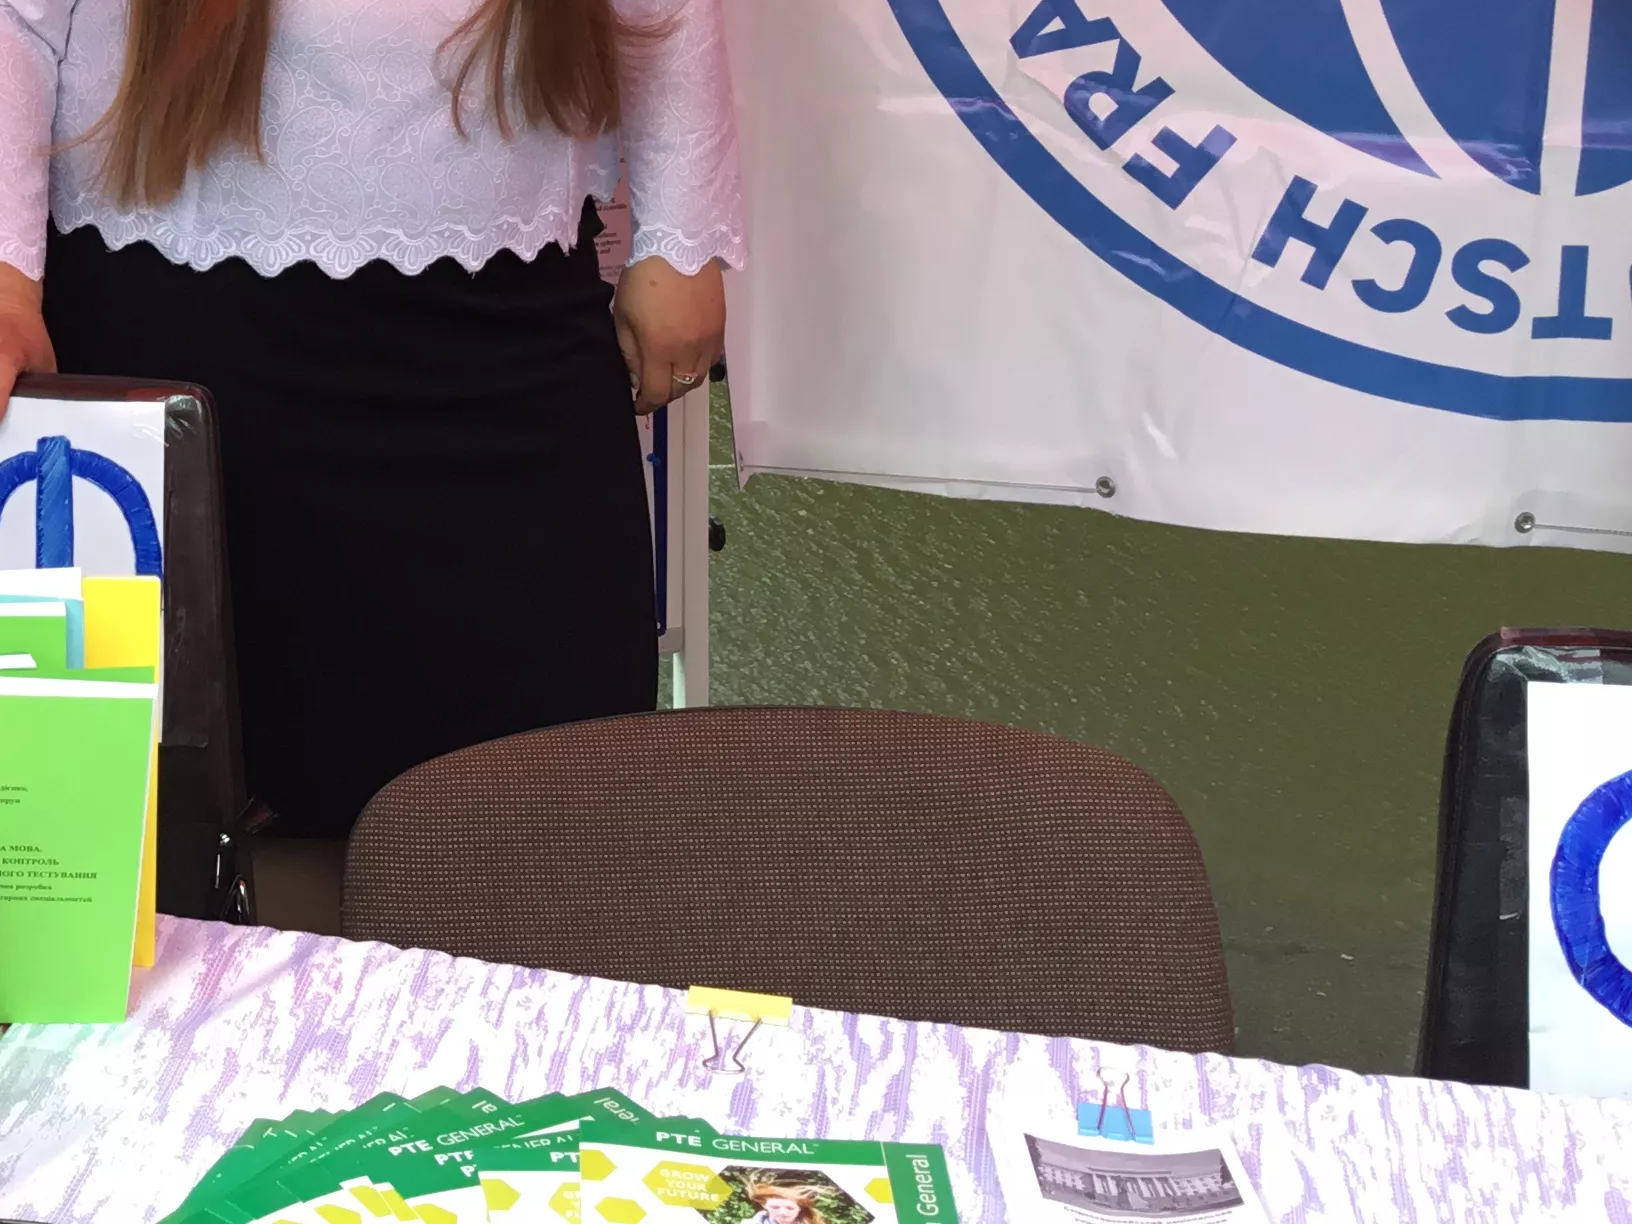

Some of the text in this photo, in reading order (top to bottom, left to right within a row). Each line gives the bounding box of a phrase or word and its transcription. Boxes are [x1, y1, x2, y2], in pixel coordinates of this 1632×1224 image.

[1250, 174, 1632, 342] TSCH
[2, 857, 60, 866] КОНТРОЛЬ
[27, 871, 98, 879] ТЕСТУВАННЯ
[388, 1139, 434, 1157] PTE
[436, 1117, 525, 1146] GENERAL
[656, 1131, 815, 1155] PTE GENERAL
[659, 1168, 709, 1183] GROW
[666, 1179, 708, 1192] YOUR
[906, 1154, 939, 1216] General
[657, 1187, 719, 1203] FUTURE
